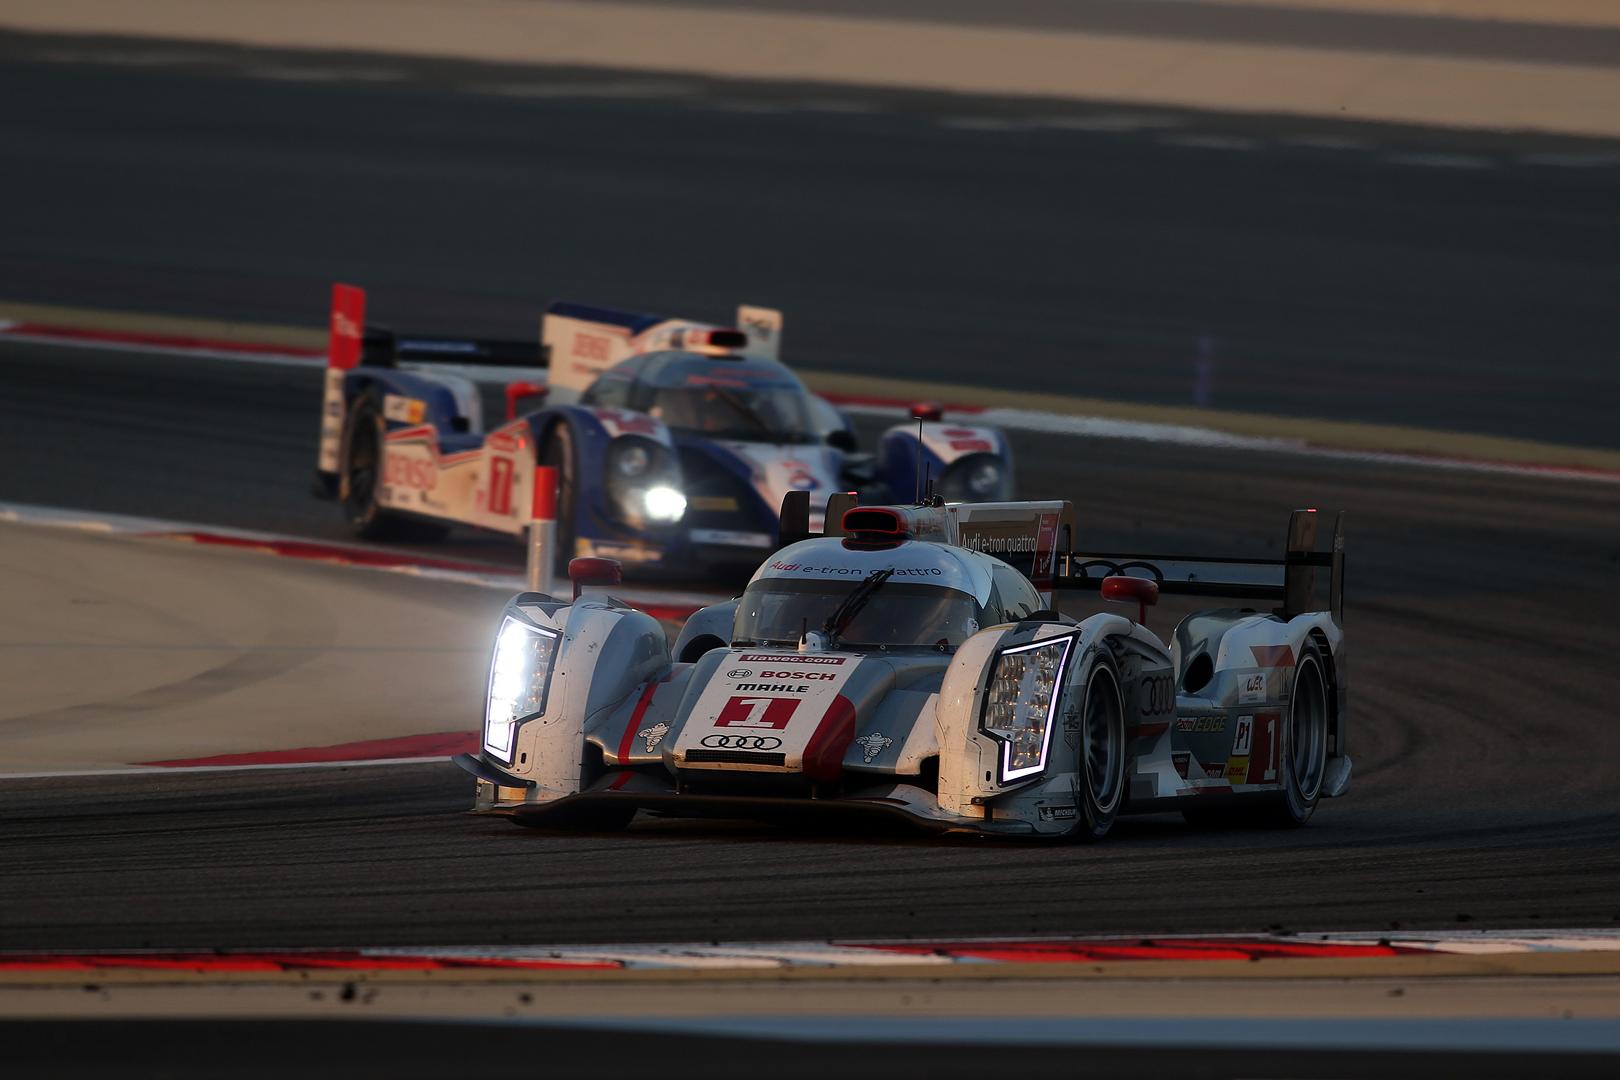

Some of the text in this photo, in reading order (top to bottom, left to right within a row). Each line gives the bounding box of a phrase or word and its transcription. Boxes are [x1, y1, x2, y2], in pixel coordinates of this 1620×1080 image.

[962, 532, 981, 552] Audi
[981, 535, 1006, 553] e-tron
[1006, 535, 1037, 558] quattro
[769, 561, 801, 571] Audi
[802, 566, 862, 576] e-tron
[745, 655, 840, 665] fiawec.com
[759, 670, 837, 681] BOSCH
[735, 683, 811, 693] MAHLE
[728, 698, 776, 728] 1
[1235, 722, 1251, 749] P1
[1263, 719, 1277, 780] 1
